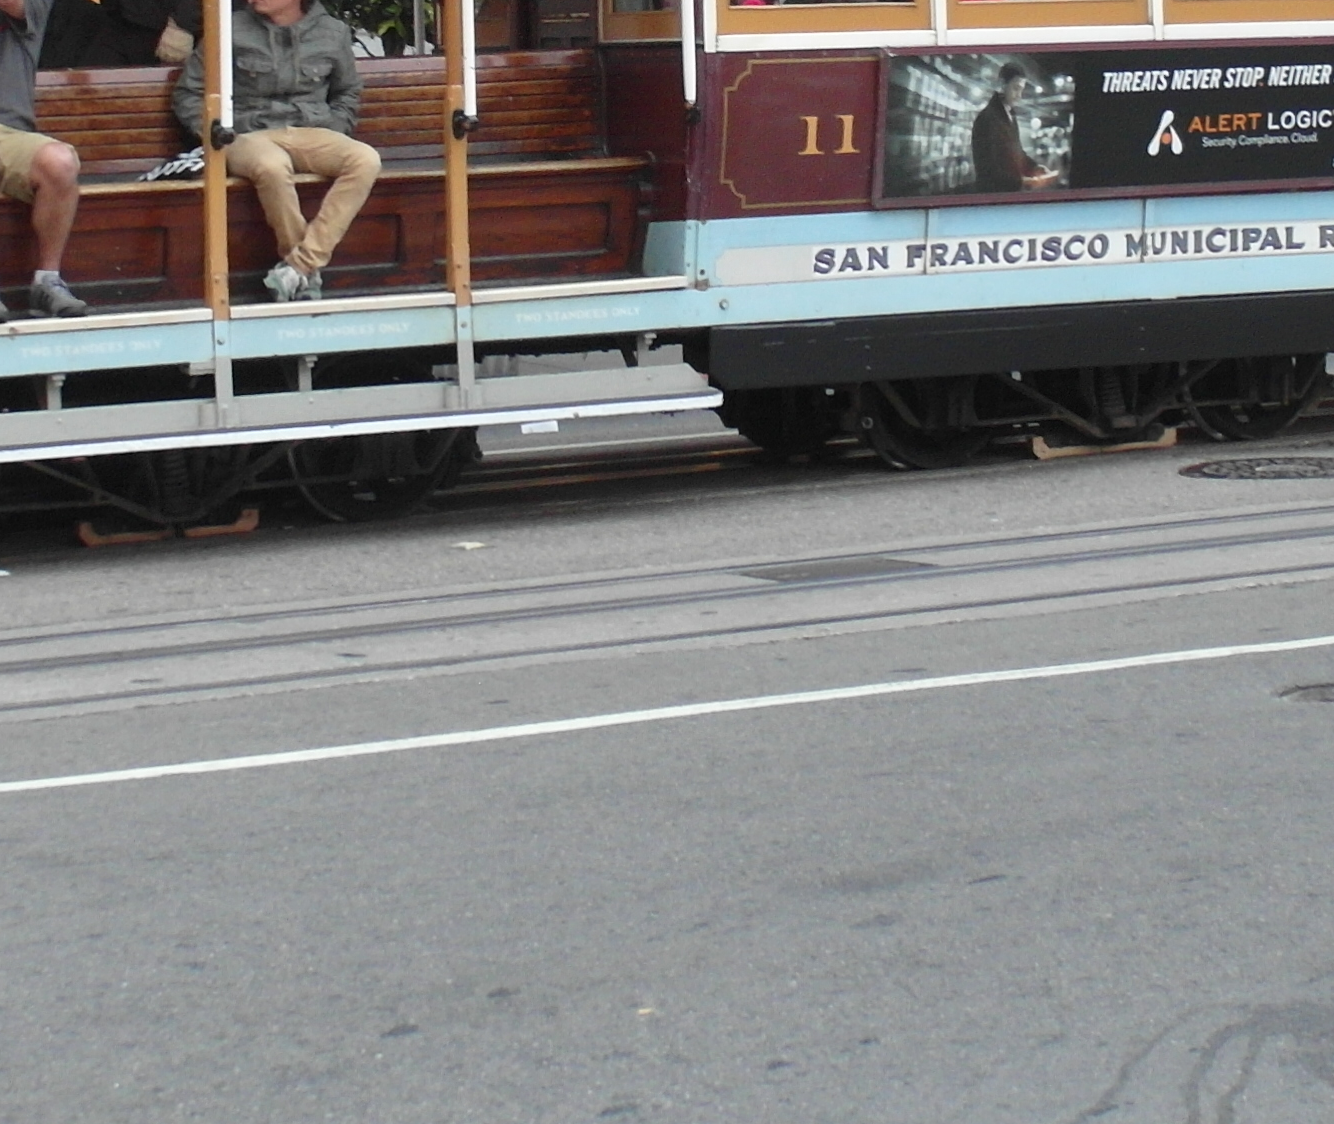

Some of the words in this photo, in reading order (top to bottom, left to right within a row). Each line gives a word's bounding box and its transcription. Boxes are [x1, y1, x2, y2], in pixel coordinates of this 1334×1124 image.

[1102, 71, 1169, 93] THREATS
[1171, 68, 1222, 91] NEVER
[1267, 64, 1331, 88] NEITHER
[797, 114, 861, 155] 11
[1187, 112, 1262, 133] ALERT
[813, 247, 889, 276] SAN
[907, 233, 1109, 269] FRANCISCO
[1126, 226, 1304, 258] MUNICIPAL
